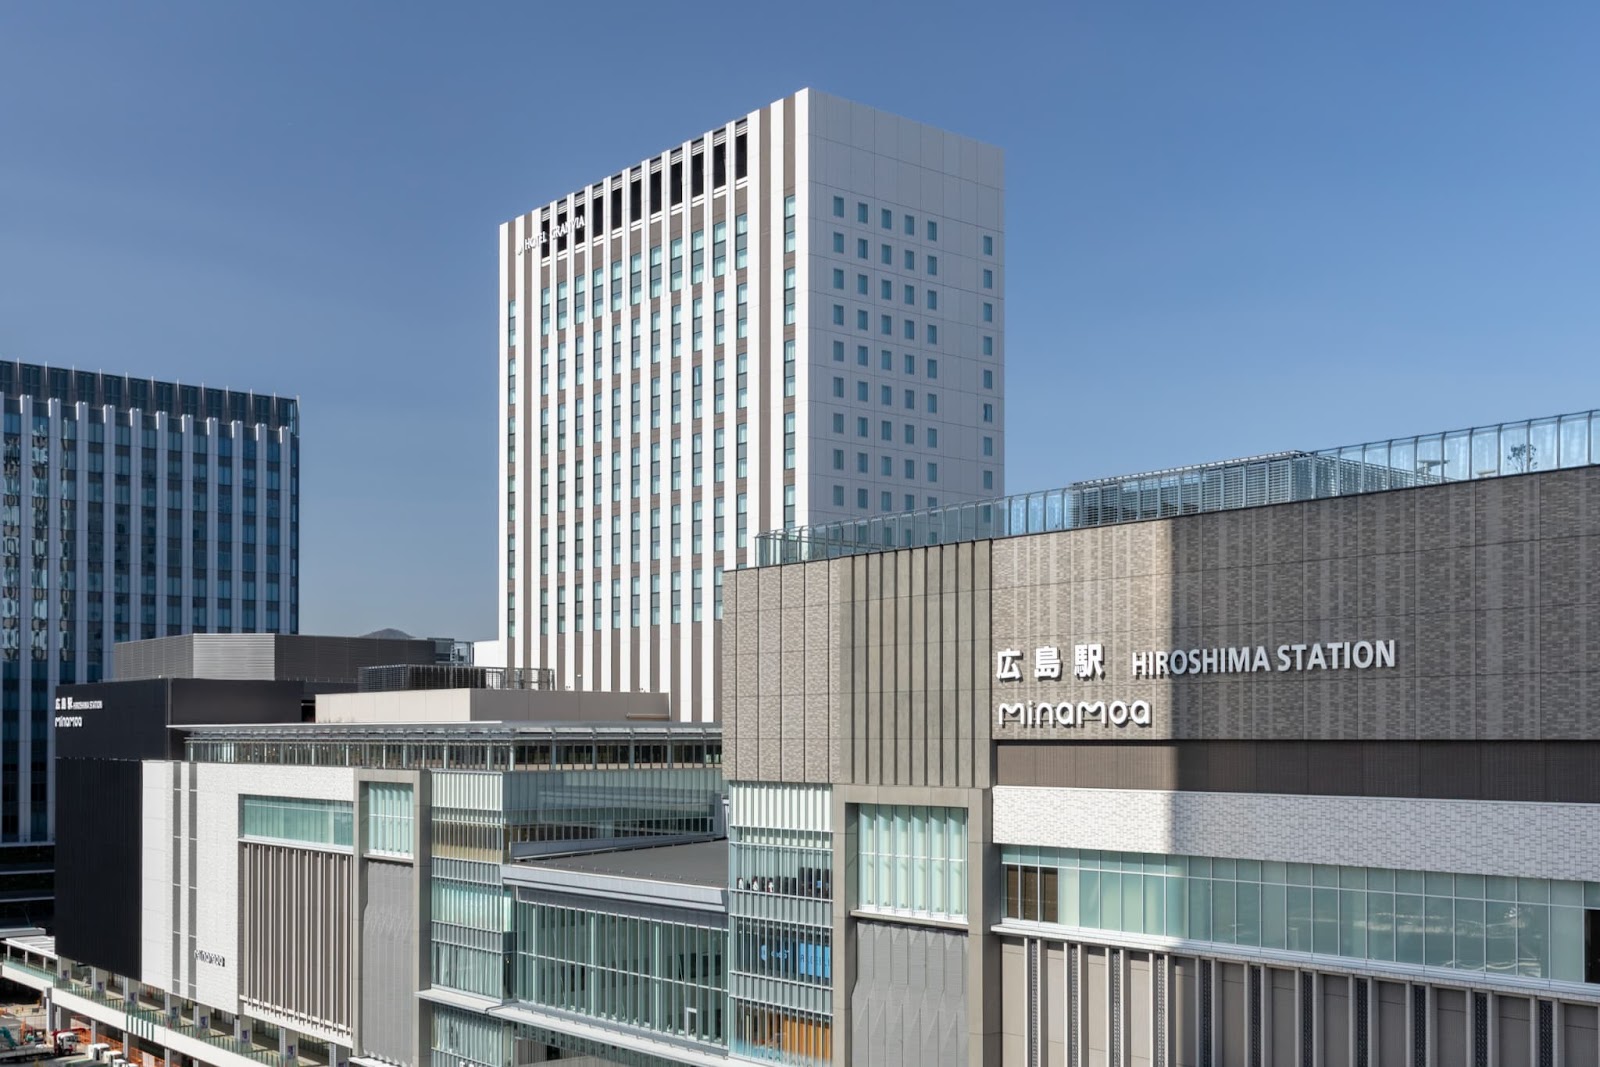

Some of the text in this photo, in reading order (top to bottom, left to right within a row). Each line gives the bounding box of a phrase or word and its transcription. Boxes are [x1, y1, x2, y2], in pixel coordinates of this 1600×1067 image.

[524, 215, 586, 250] HOTEL GRANVIA
[996, 639, 1396, 680] 広島駅 HIROSHIMA STATION
